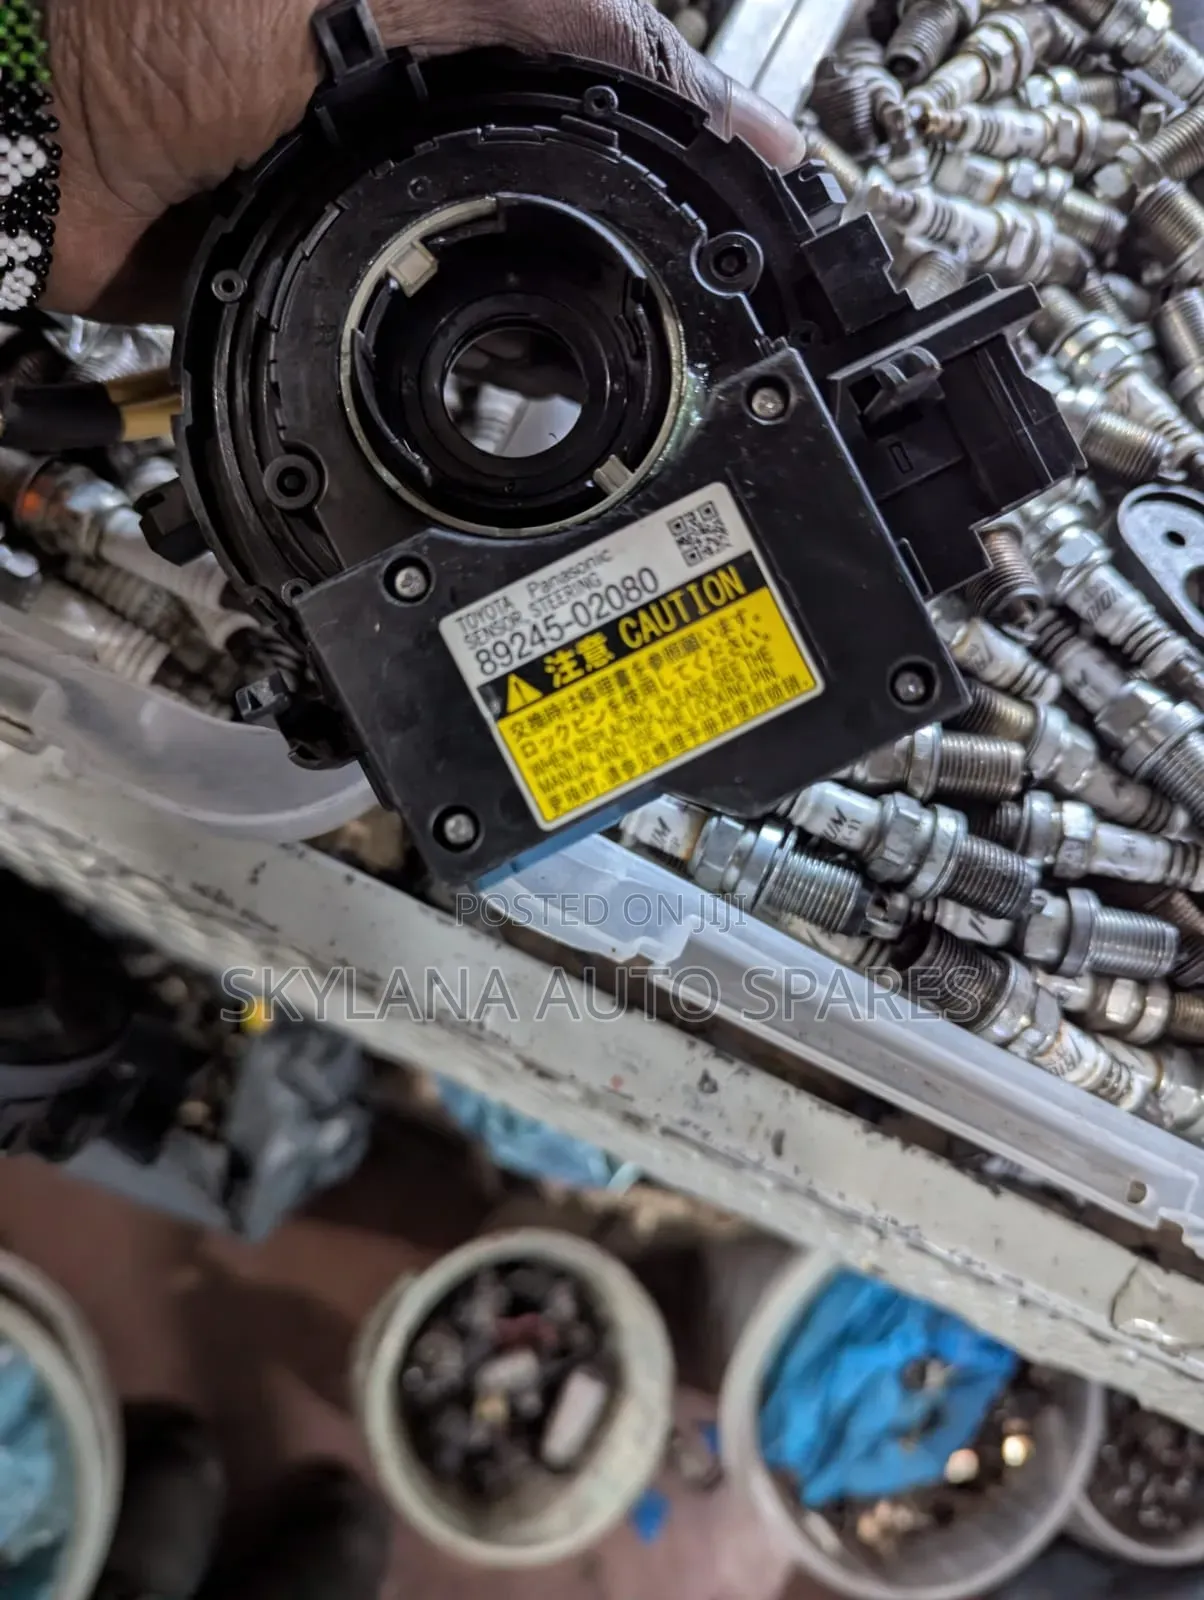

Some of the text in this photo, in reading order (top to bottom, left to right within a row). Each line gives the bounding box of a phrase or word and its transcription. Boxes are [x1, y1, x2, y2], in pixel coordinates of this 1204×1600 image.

[526, 549, 613, 598] Panasonic
[529, 571, 602, 618] STEERING
[455, 595, 513, 633] TOYOTA
[475, 566, 660, 676] 89245-02080
[542, 564, 747, 688] 注意 CAUTION
[712, 659, 743, 685] SEE
[742, 644, 773, 670] THE
